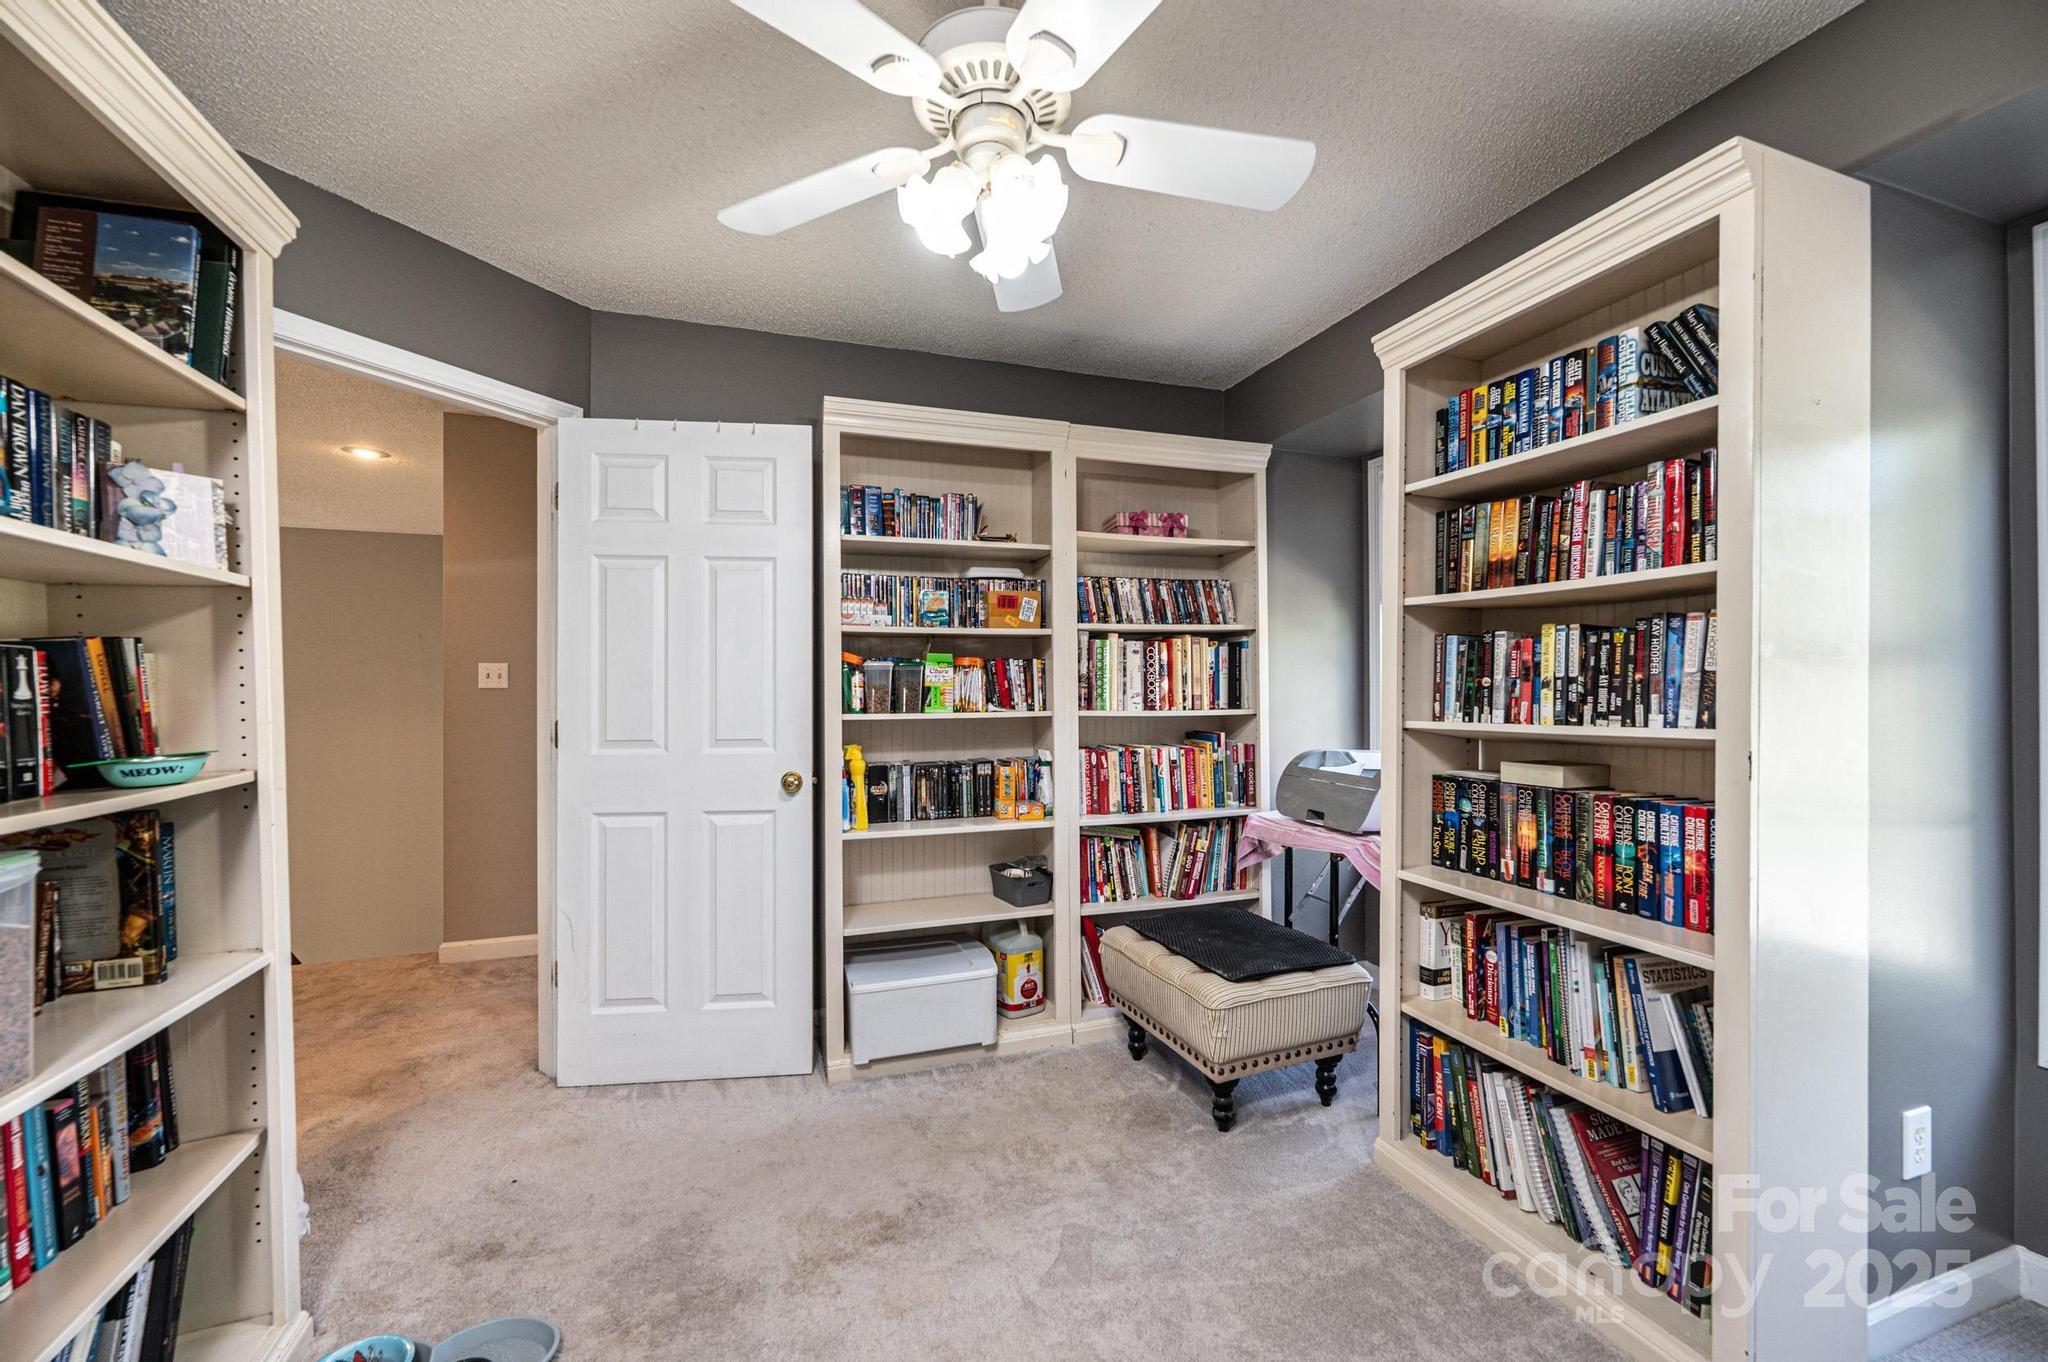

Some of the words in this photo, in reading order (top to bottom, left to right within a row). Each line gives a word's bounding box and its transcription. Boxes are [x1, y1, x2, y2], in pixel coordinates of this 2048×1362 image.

[226, 271, 237, 306] Oceanic
[222, 307, 234, 356] Wilderness
[1672, 319, 1684, 334] MARY
[1681, 331, 1696, 352] HIGGINS
[1693, 348, 1708, 366] CLARK
[1686, 309, 1699, 329] Mary
[1696, 324, 1713, 348] Higgins
[1618, 336, 1627, 384] CUSSLER
[1626, 340, 1636, 374] CLIVE
[1649, 326, 1662, 344] Mary
[1659, 338, 1677, 360] Higgins
[1671, 356, 1686, 374] Clark
[1533, 367, 1541, 400] CUSSLER
[1552, 361, 1561, 380] CLIVE
[1567, 358, 1575, 387] CUSSLER
[1574, 359, 1582, 381] CLIVE
[10, 384, 26, 418] DAN
[1503, 381, 1511, 404] CUSSLER
[1521, 377, 1530, 400] CLIVE
[1541, 375, 1549, 400] CLIVE
[1552, 380, 1561, 408] CUSSLER
[1519, 400, 1529, 434] CUSSLER
[11, 421, 28, 479] BROWN
[76, 416, 87, 464] CATHERINE
[1521, 502, 1531, 519] NORA
[1574, 487, 1582, 503] IRIS
[1691, 495, 1699, 520] JOHANSEN
[1520, 520, 1530, 540] ROBERTS
[1572, 504, 1582, 542] JOHANSEN
[1607, 508, 1616, 539] JOHANSEN
[1625, 508, 1633, 539] JOHANSEN
[1648, 496, 1662, 548] JOHANSEN
[1650, 618, 1660, 638] KAY
[1650, 638, 1659, 675] HOOPER
[1706, 636, 1716, 667] HOOPER
[97, 653, 110, 694] LOWELL
[1147, 647, 1155, 702] COOKBOOK
[1704, 672, 1715, 706] HAVEN
[119, 764, 185, 780] MEOW!
[1471, 783, 1479, 817] COULTER
[1478, 784, 1486, 818] CATHERINE
[1518, 789, 1526, 822] COULTER
[1525, 790, 1533, 821] CATHERINE
[1554, 794, 1563, 838] COULTER
[1562, 794, 1573, 840] CATHERINE
[1593, 801, 1602, 839] COULTER
[1601, 802, 1610, 841] CATHERINE
[1613, 805, 1624, 846] COULTER
[1623, 806, 1634, 848] CATHERINE
[1637, 809, 1646, 842] COULTER
[1646, 810, 1656, 843] CATHERINE
[1660, 813, 1670, 846] COULTER
[1669, 814, 1679, 848] CATHERINE
[1685, 816, 1695, 850] COULTER
[1695, 818, 1706, 852] CATHERINE
[1477, 834, 1486, 866] BLIND
[1554, 851, 1563, 876] OUT
[1562, 850, 1572, 881] BLOW
[1597, 857, 1605, 880] KNOCK
[1615, 863, 1623, 894] BLANK
[1621, 865, 1633, 897] POINT
[1597, 881, 1605, 900] OUT
[1466, 919, 1474, 947] AMERICAN
[1487, 963, 1495, 1007] Dictionary
[1643, 966, 1708, 985] STATISTICS
[1435, 1071, 1443, 1096] PASS
[1472, 1085, 1481, 1117] ABNORMAL
[1499, 1099, 1513, 1140] EVERGREEN
[1587, 1122, 1623, 1142] MADE
[116, 1127, 129, 1152] play
[118, 1153, 130, 1182] dirty
[1652, 1165, 1660, 1176] Core
[1650, 1177, 1659, 1203] Curriculum
[1682, 1181, 1690, 1193] Core
[1596, 1173, 1614, 1208] SIGNING
[1610, 1206, 1624, 1233] MADE
[1619, 1233, 1634, 1258] EASY
[1648, 1211, 1656, 1232] Oncology
[1659, 1205, 1670, 1238] SECRETS
[1679, 1193, 1690, 1220] Curriculum
[1701, 1216, 1710, 1228] Core
[1646, 1233, 1654, 1252] Nursing
[1675, 1228, 1685, 1249] Oncology
[1693, 1219, 1701, 1239] Oncology
[1700, 1228, 1709, 1256] Curriculum
[1673, 1250, 1683, 1269] Nursing
[1690, 1240, 1699, 1262] Nursing
